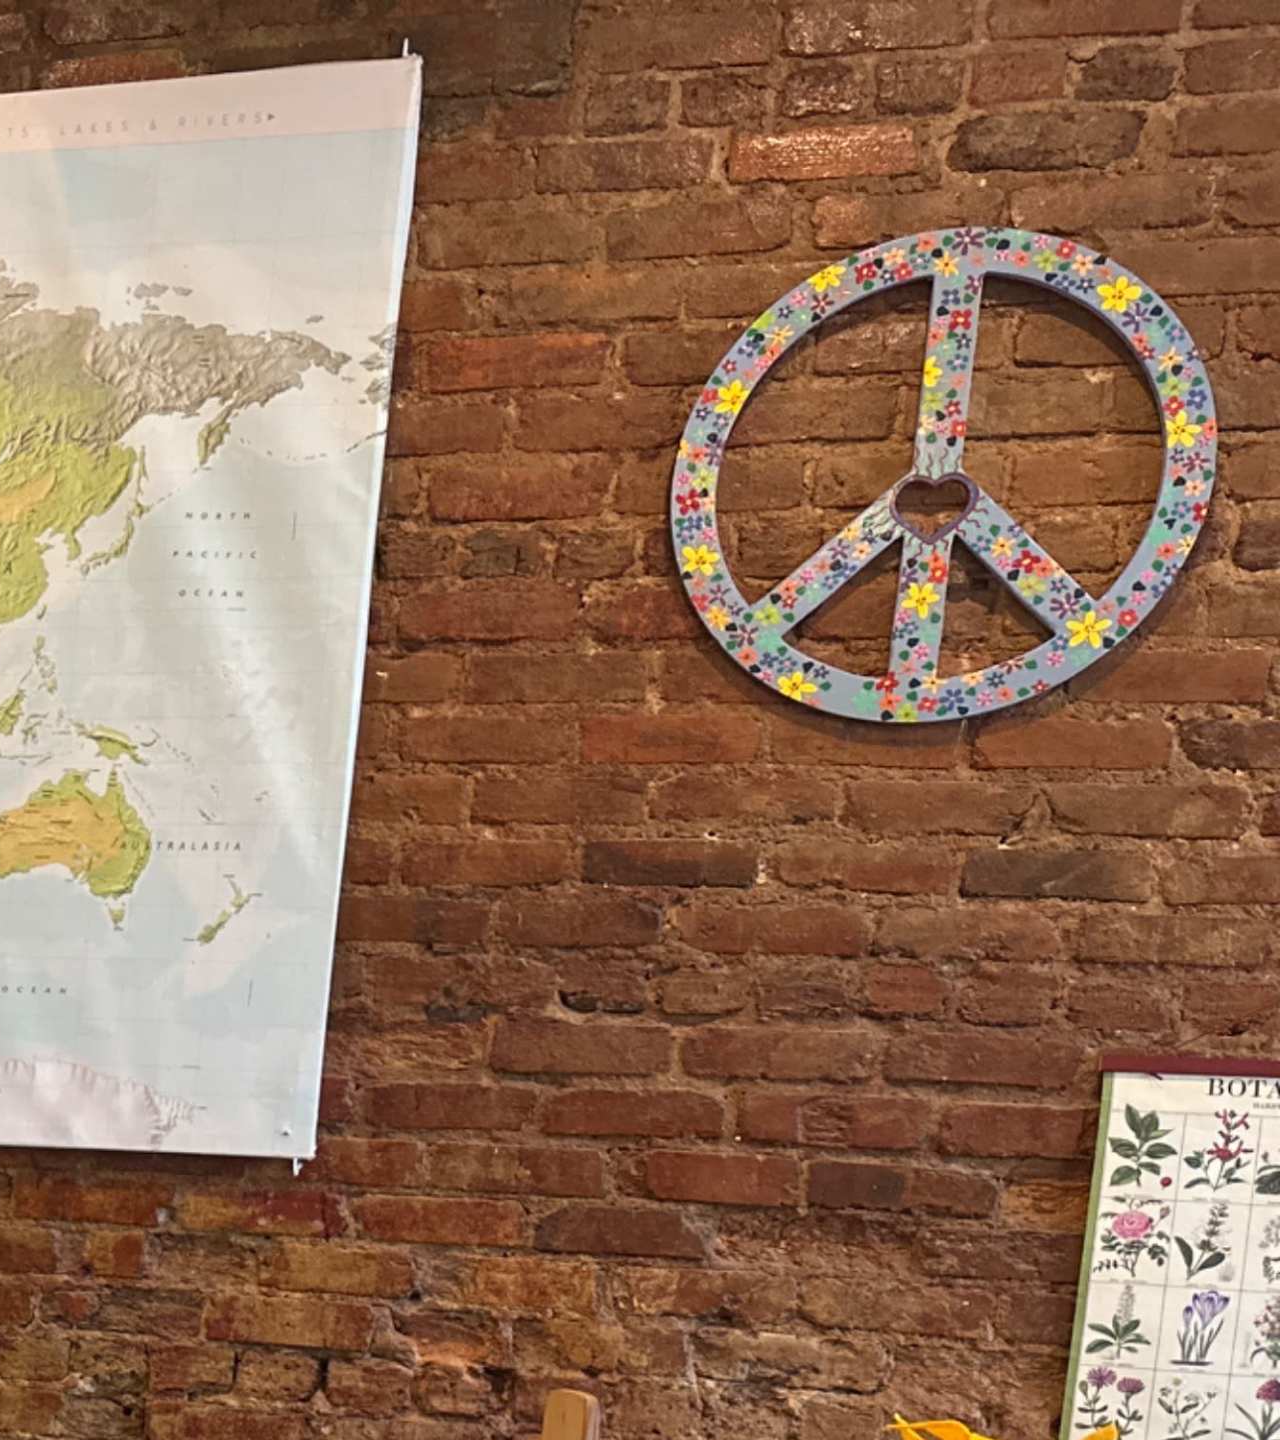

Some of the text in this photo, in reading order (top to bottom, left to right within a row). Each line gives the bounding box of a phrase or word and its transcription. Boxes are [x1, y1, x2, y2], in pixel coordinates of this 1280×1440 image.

[58, 120, 130, 137] LAKES
[177, 111, 265, 128] RIVERS
[117, 840, 243, 852] AUSTRALASIA
[0, 984, 70, 995] OCEAN
